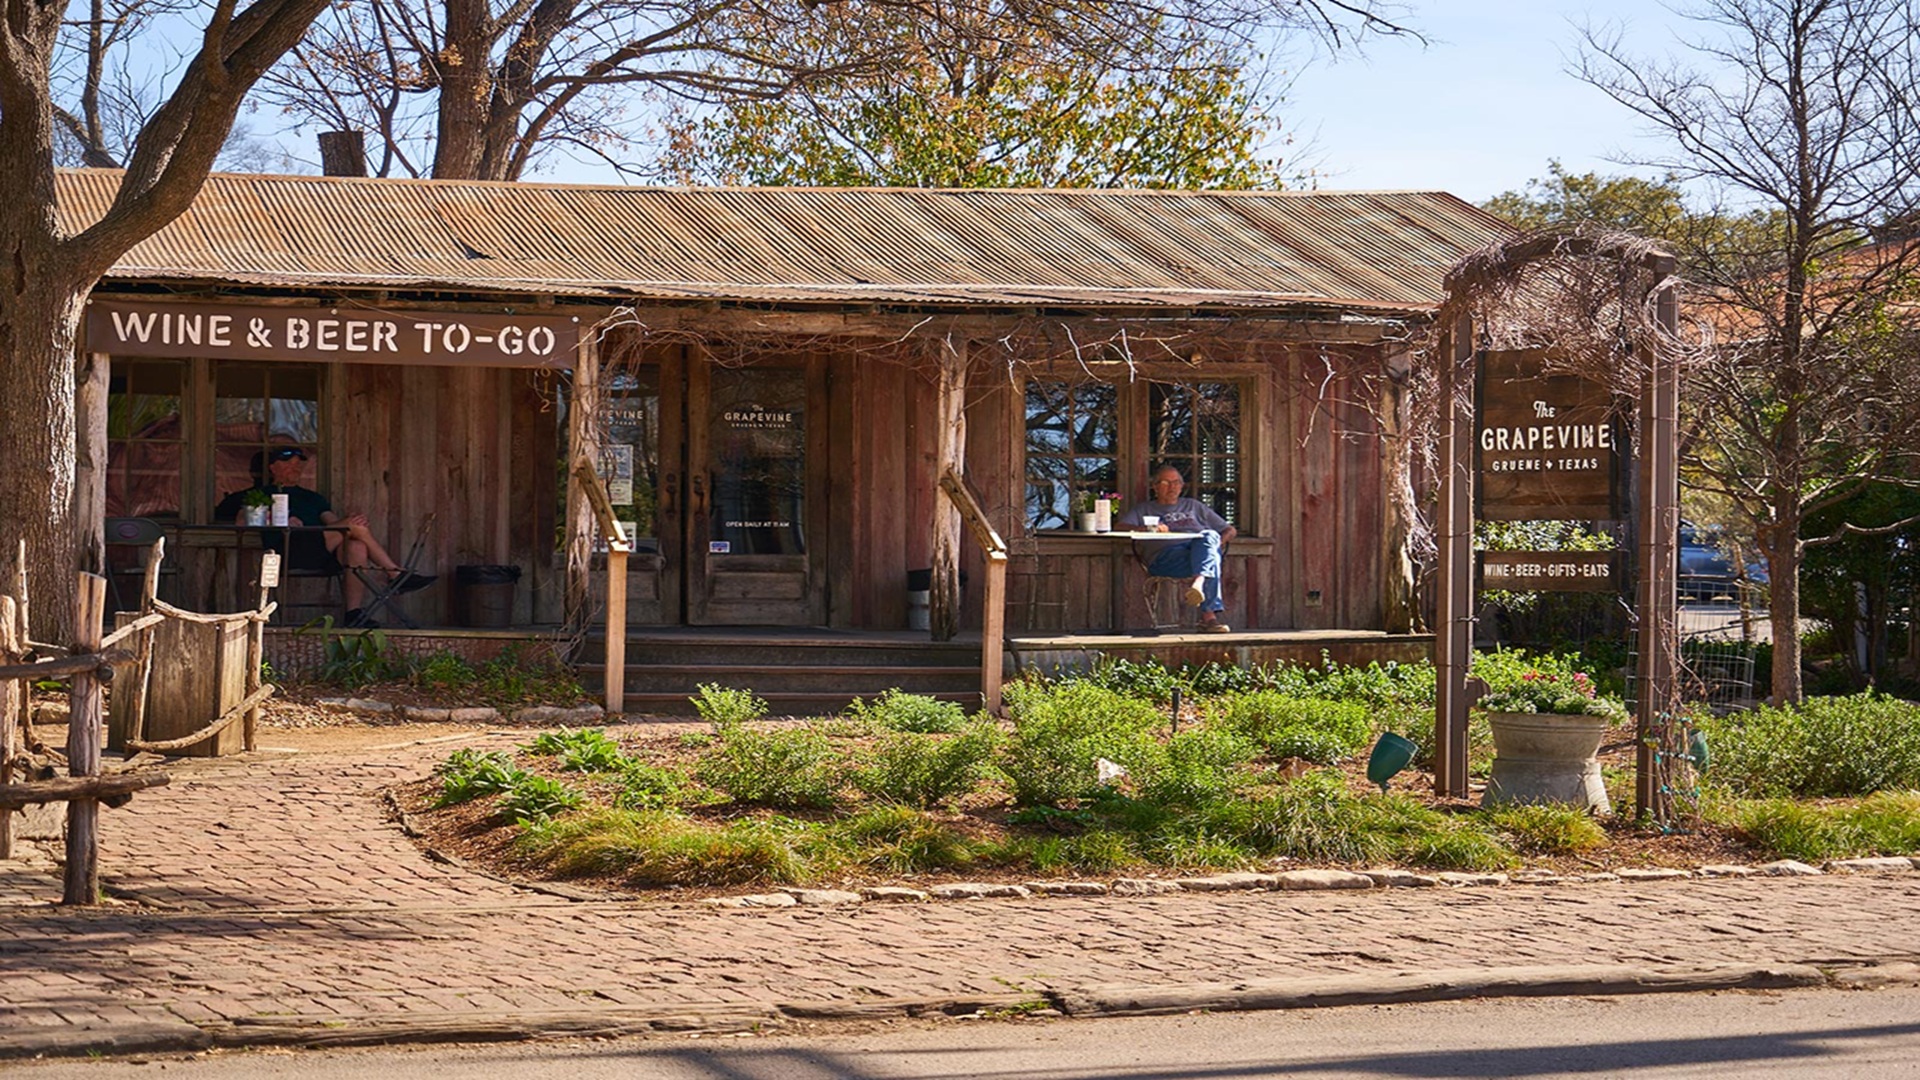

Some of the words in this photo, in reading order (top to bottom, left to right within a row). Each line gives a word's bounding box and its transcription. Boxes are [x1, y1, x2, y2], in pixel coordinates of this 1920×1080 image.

[111, 312, 232, 346] WINE
[247, 317, 273, 348] &
[287, 318, 398, 352] BEER
[414, 323, 555, 356] TO-GO
[724, 412, 792, 422] GRAPEVINE
[1533, 400, 1556, 418] The
[1481, 424, 1610, 451] GRAPEVINE
[1492, 460, 1540, 471] GRUENE
[1558, 458, 1598, 471] TEXAS
